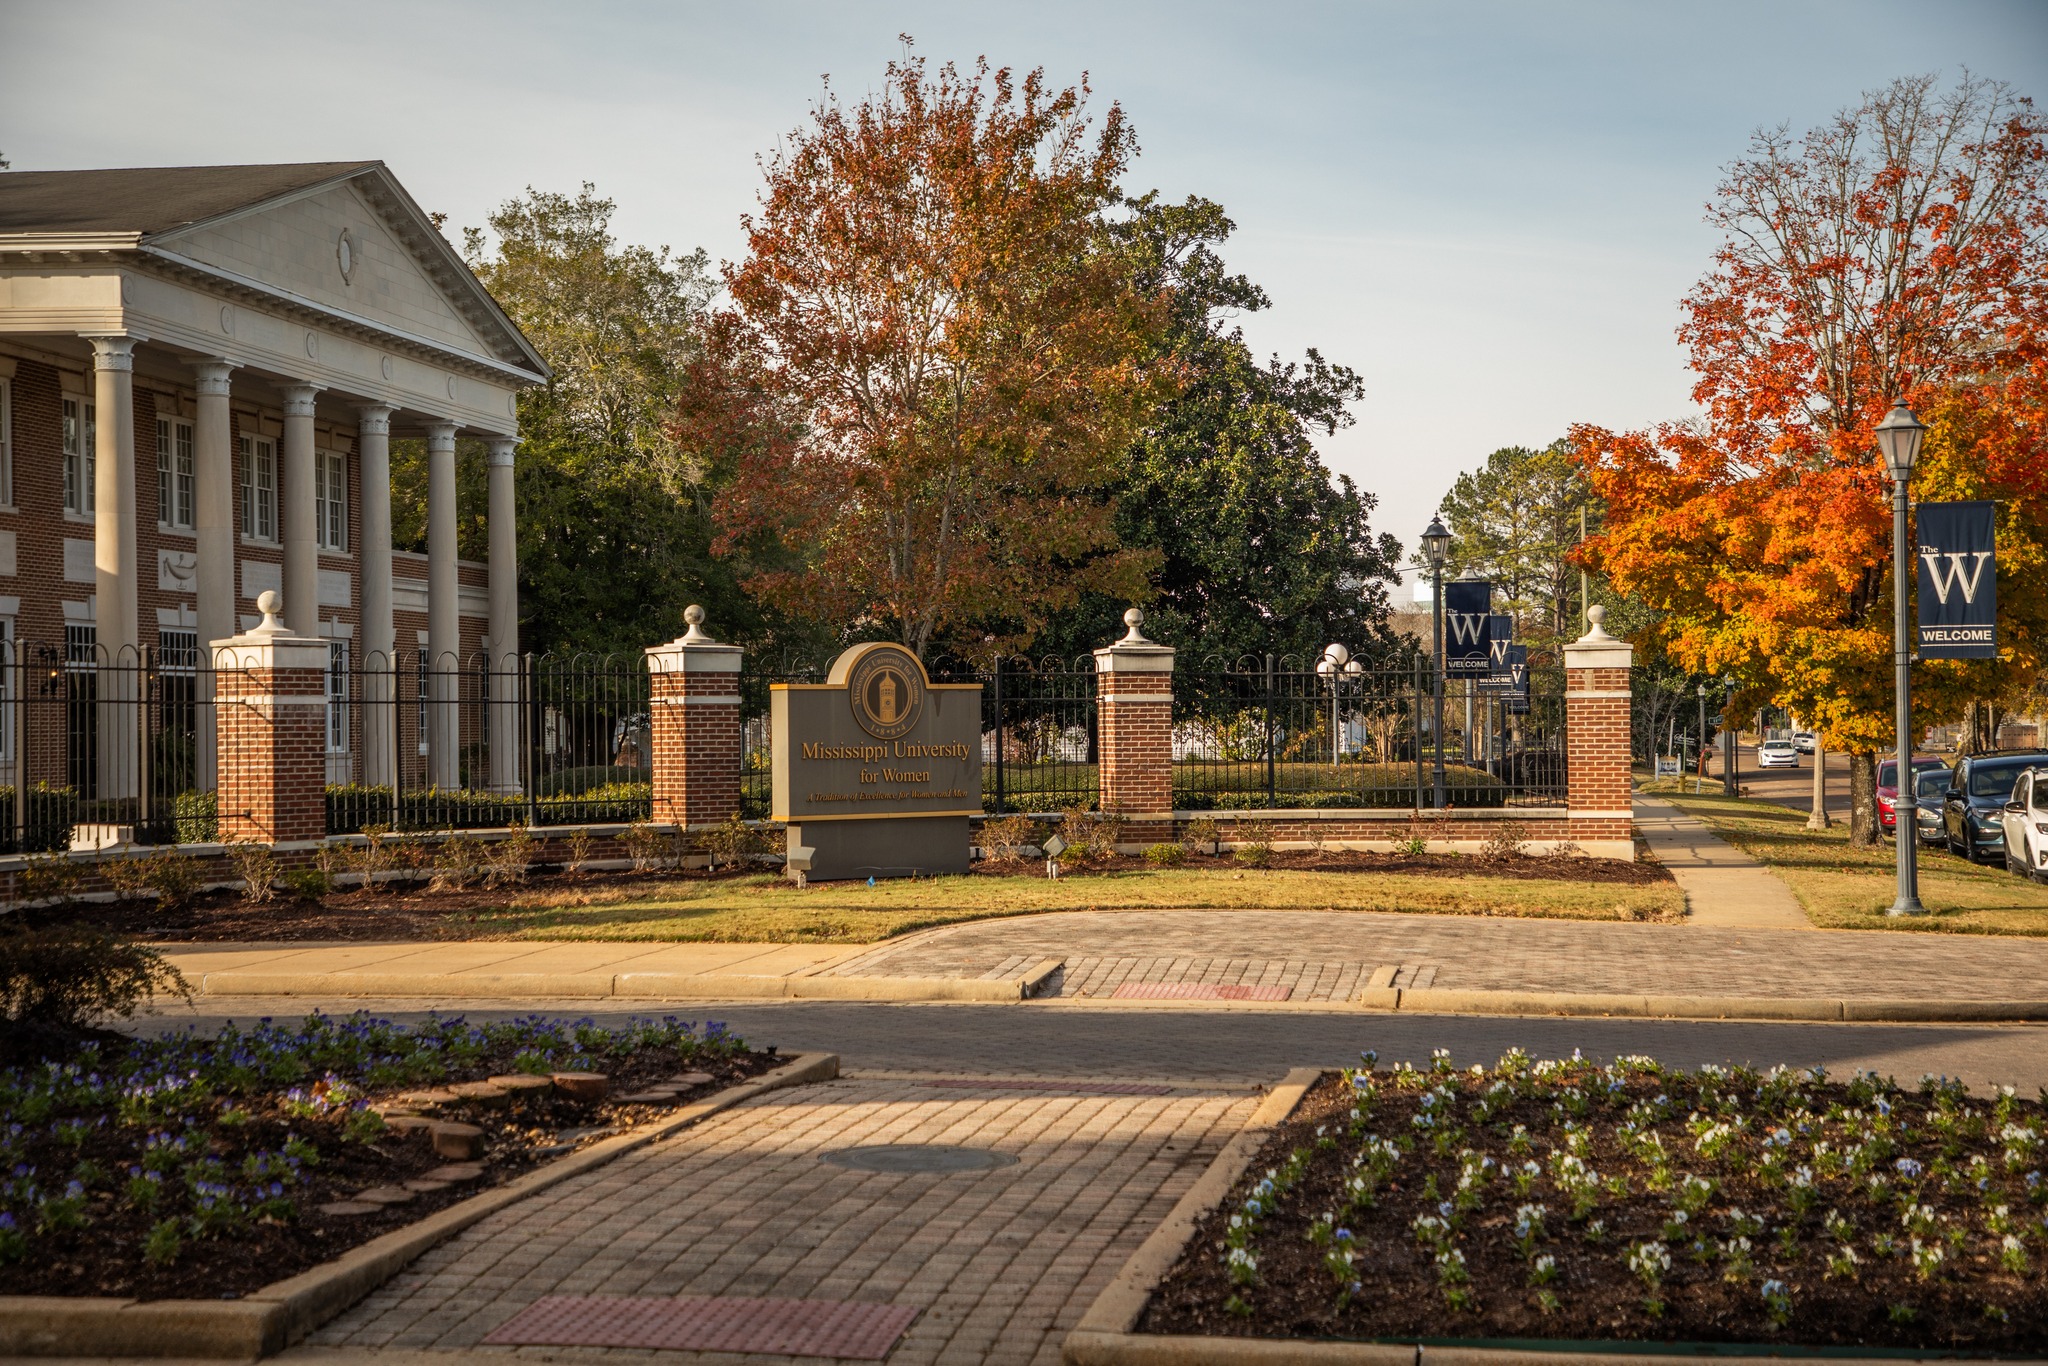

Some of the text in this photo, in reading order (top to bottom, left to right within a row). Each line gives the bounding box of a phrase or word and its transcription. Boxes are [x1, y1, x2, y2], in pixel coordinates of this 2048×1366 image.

[1920, 551, 1993, 604] W
[1447, 613, 1488, 645] W
[1922, 630, 1992, 641] WELCOME
[855, 656, 919, 705] Mississippi University for Women
[802, 740, 970, 763] Mississippi University
[860, 768, 930, 784] for Women
[807, 789, 968, 802] A Tradition of Excellence for Women and Men
